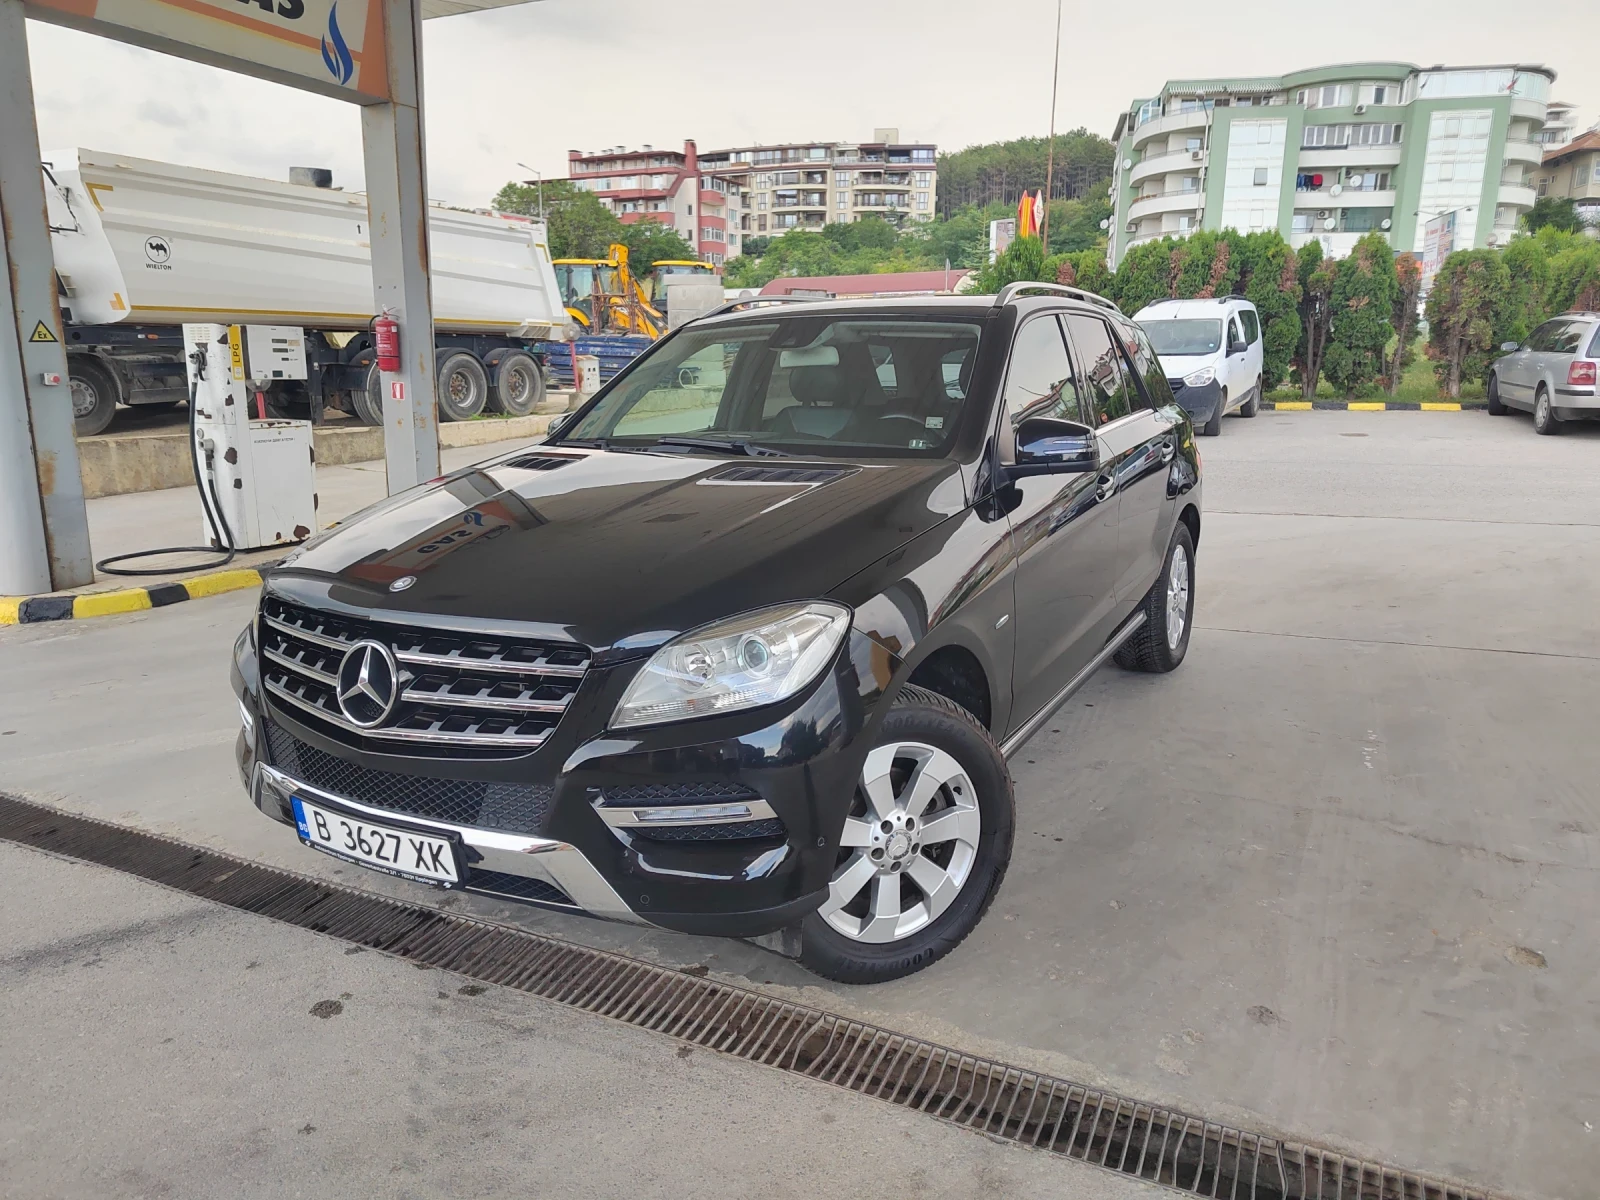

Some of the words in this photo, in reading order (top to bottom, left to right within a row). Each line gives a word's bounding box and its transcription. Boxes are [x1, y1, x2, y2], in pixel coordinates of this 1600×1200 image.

[37, 331, 48, 339] Ex
[232, 343, 240, 363] LPG
[298, 821, 309, 833] BG
[313, 810, 331, 842] B
[340, 820, 401, 864] 3627
[408, 838, 452, 876] XK
